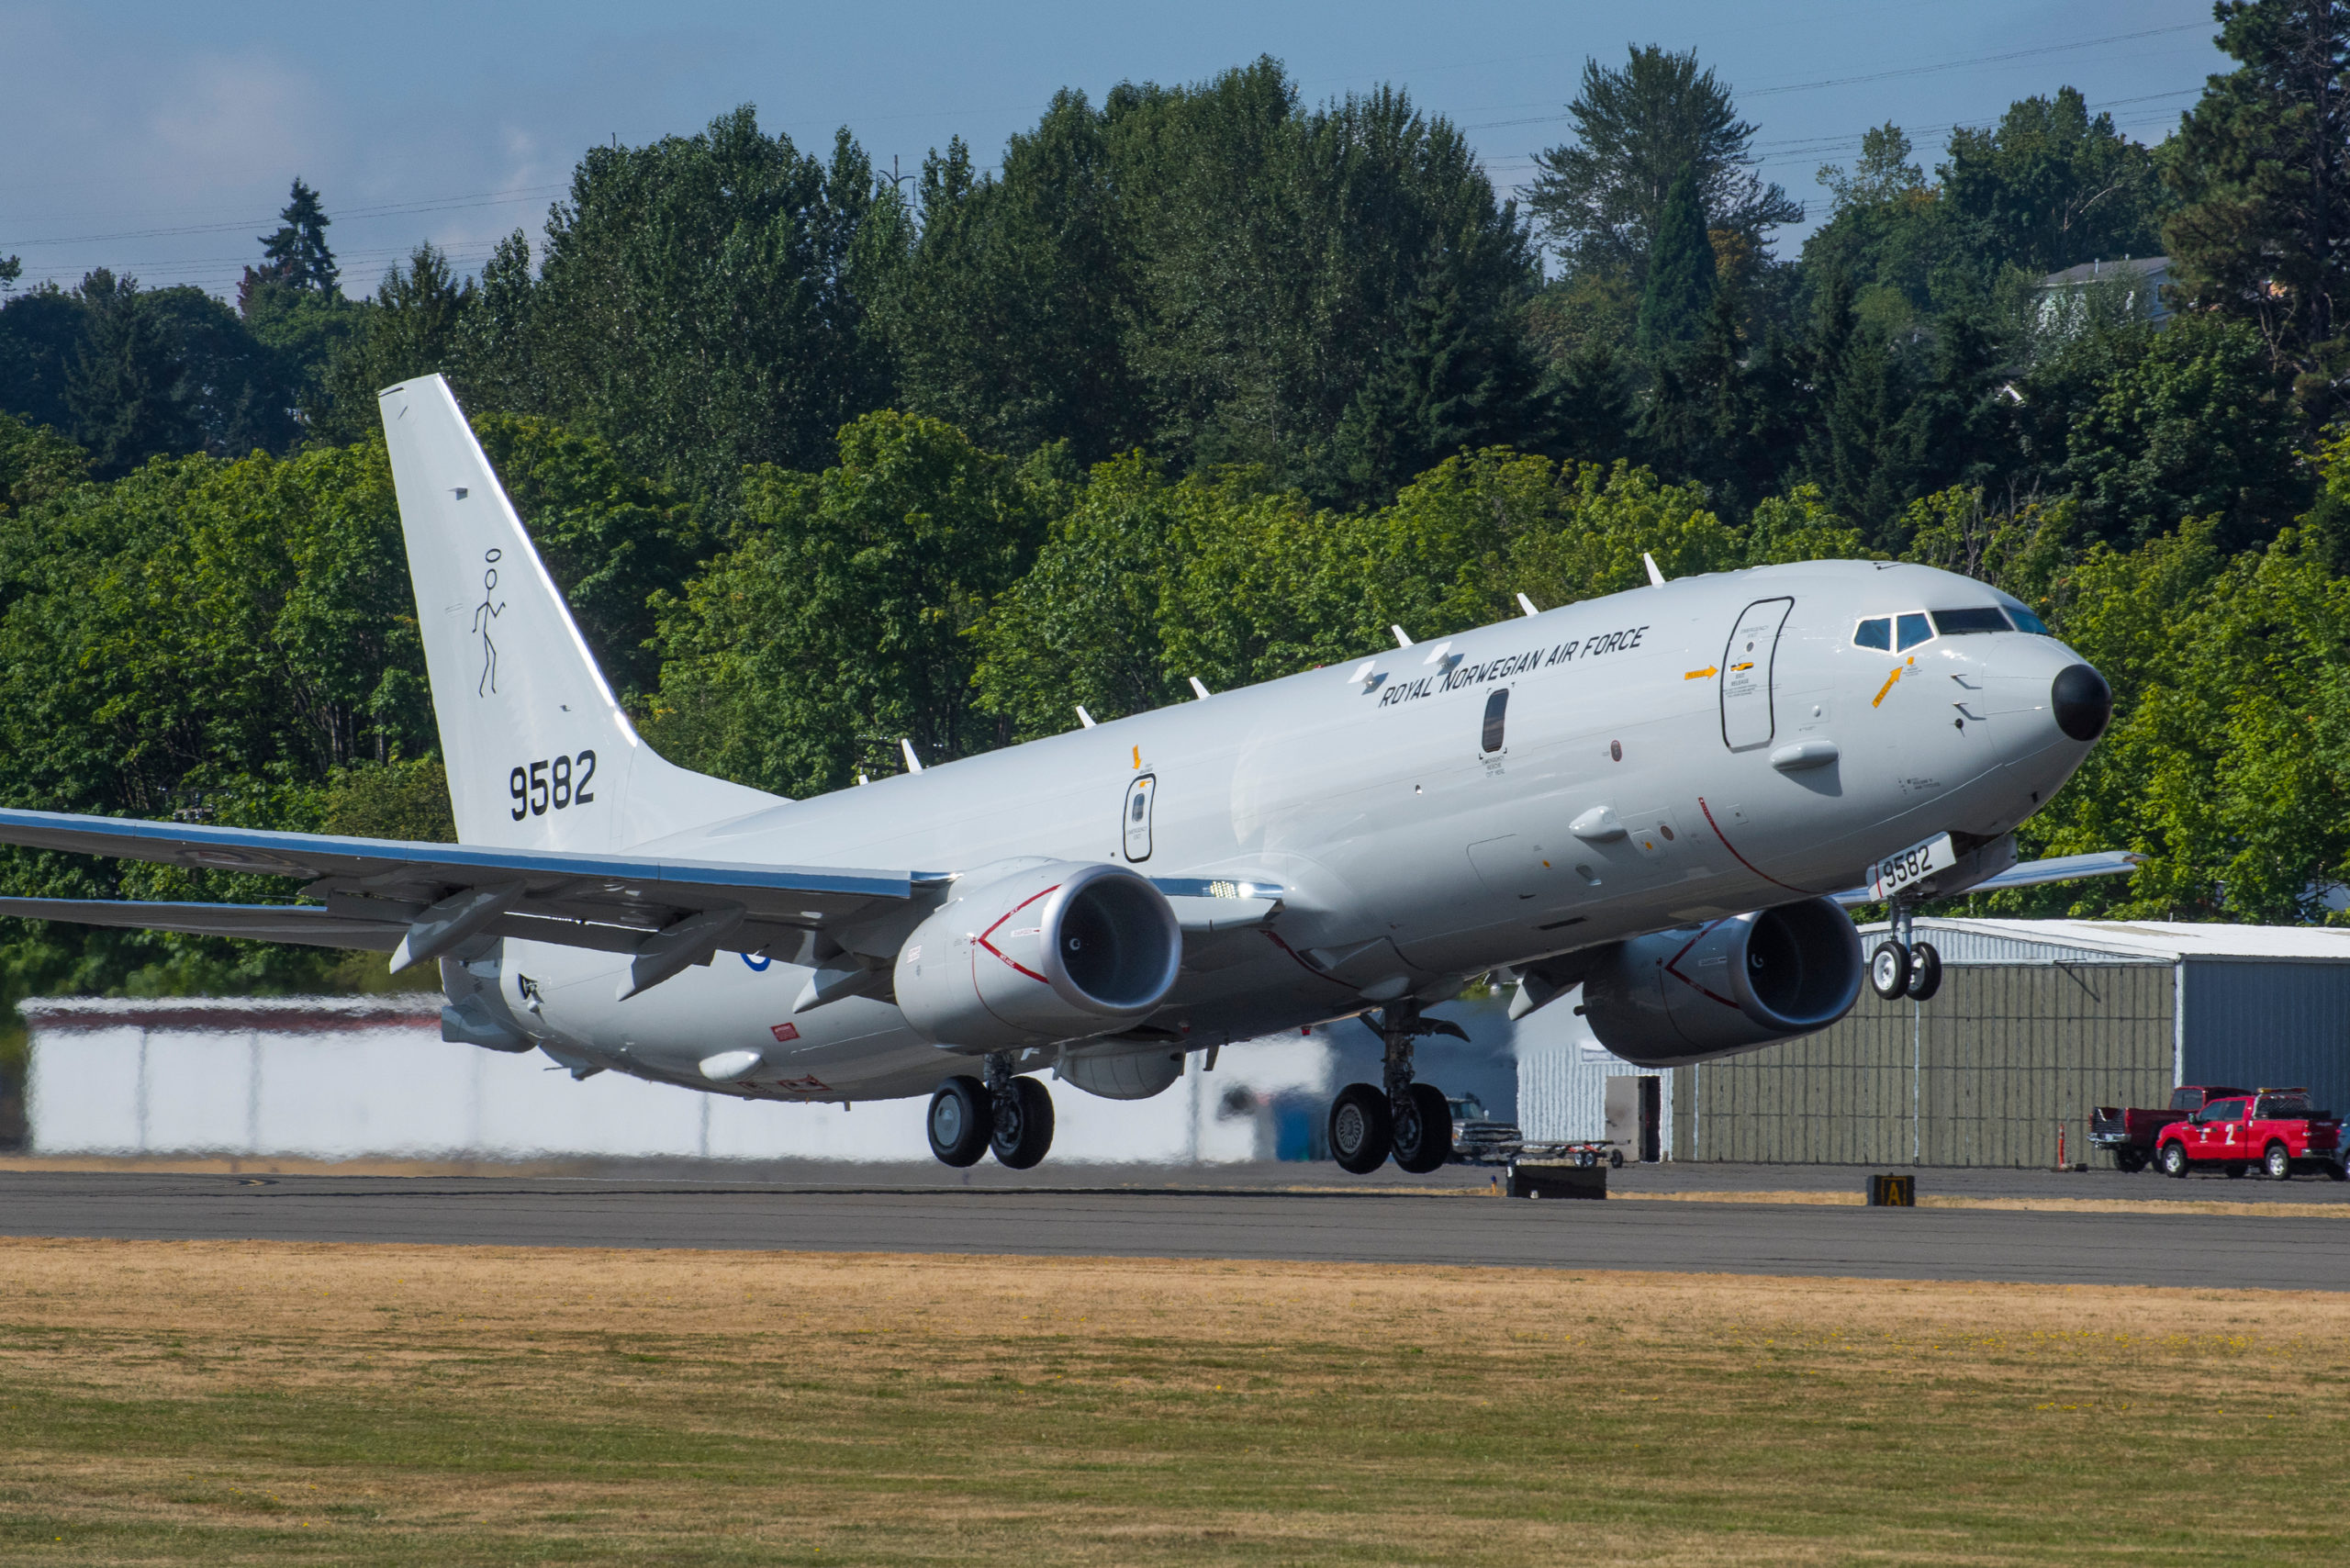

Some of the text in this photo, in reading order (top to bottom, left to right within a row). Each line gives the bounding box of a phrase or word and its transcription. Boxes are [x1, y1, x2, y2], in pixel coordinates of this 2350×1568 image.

[1378, 625, 1650, 708] ROYAL NORWEGIAN AIR FORCE
[509, 749, 596, 822] 9582
[1883, 846, 1933, 888] 9582
[2225, 1124, 2236, 1145] 2
[1887, 1182, 1901, 1205] A
